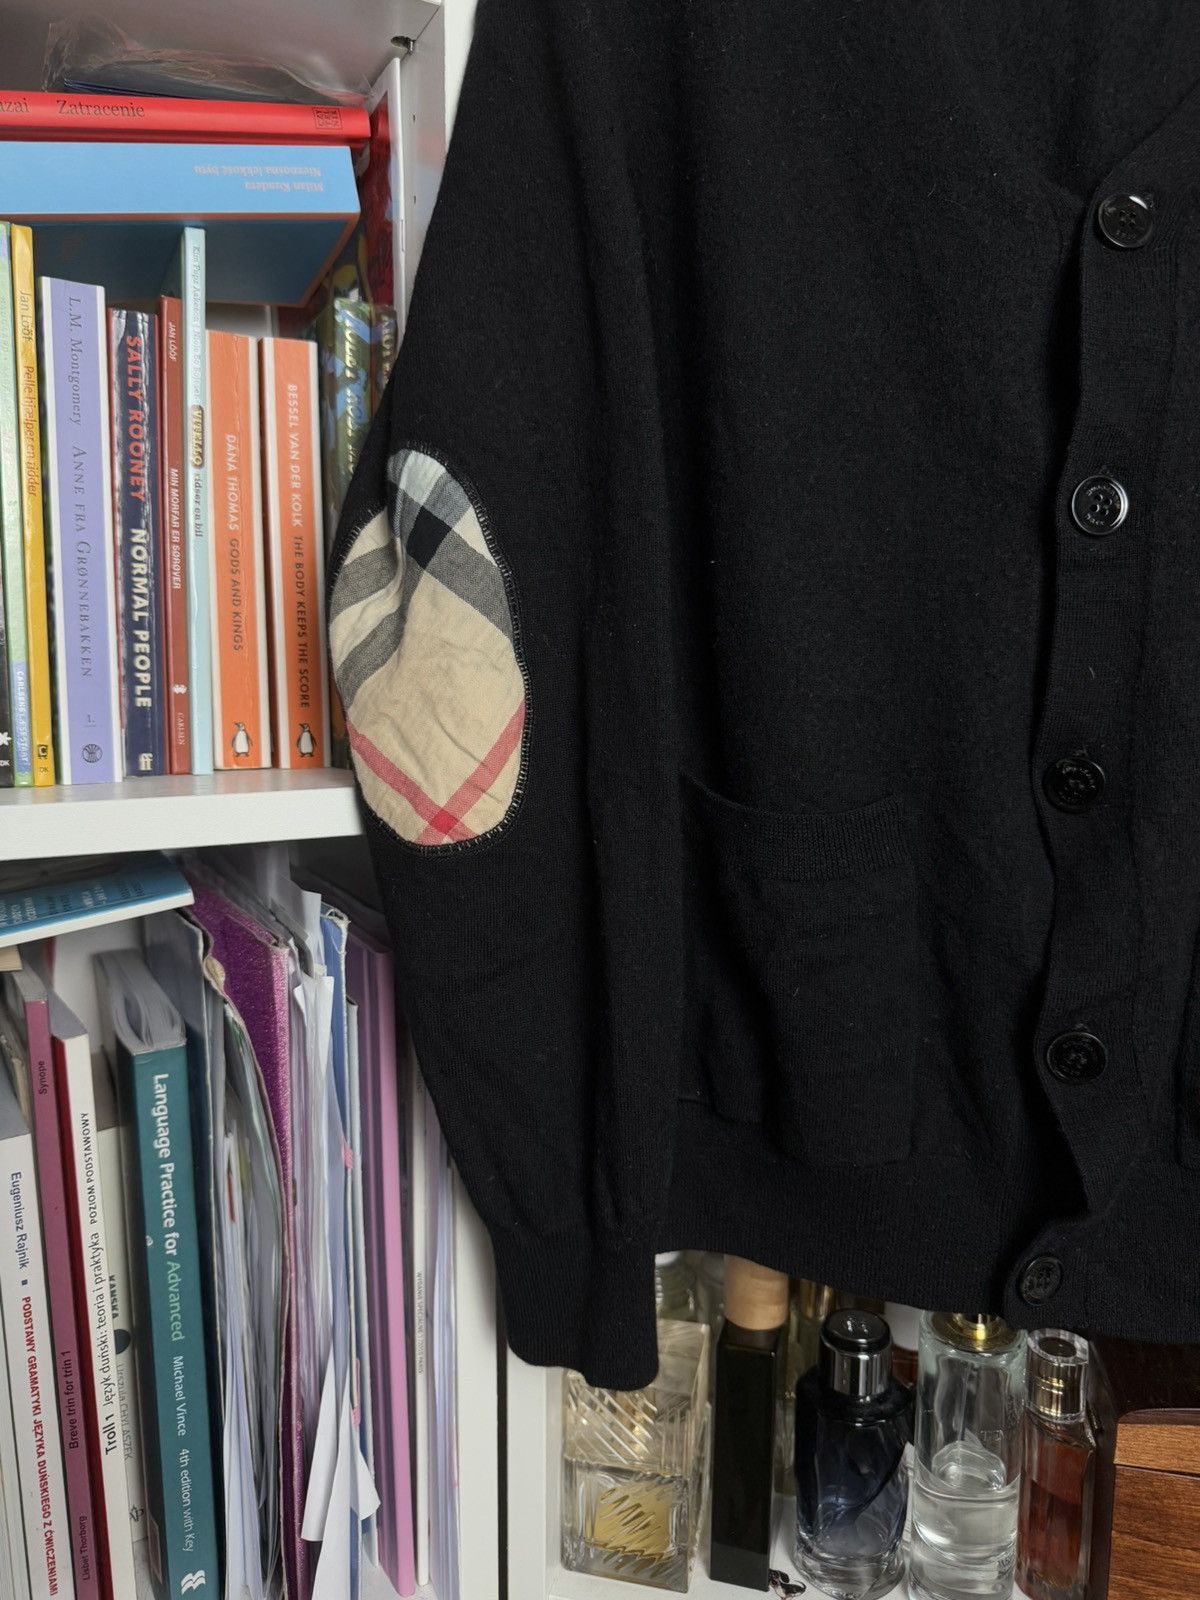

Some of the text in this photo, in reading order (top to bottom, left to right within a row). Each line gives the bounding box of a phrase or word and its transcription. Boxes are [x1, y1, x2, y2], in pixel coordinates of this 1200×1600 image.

[56, 99, 146, 117] Zatracenie
[19, 291, 31, 312] Jan
[169, 322, 177, 338] JAN
[24, 365, 36, 392] Pelle
[22, 395, 38, 442] hjælper
[26, 444, 36, 460] en
[68, 296, 92, 677] L.M. Montgomery ANNE FRA GRØNNEBAKKEN
[170, 468, 179, 486] MIN
[126, 335, 152, 708] SALLY ROONEY NORMAL PEOPLE
[171, 488, 180, 528] MORFAR
[172, 530, 180, 543] ER
[225, 434, 244, 652] DANA THOMAS GODS AND KINGS
[287, 384, 311, 709] BESSEL VAN DER KOLK THE BODY KEEPS THE SCORE
[38, 1060, 48, 1096] Synope
[80, 1112, 95, 1184] PODSTAWOWY
[87, 1184, 98, 1225] POZIOM
[88, 1232, 106, 1285] praktyka
[96, 1294, 108, 1329] teoria
[152, 1073, 195, 1553] Language Practice for Advanced Michael Vince 4th edition with Key
[63, 1358, 73, 1375] trin
[97, 1331, 112, 1375] duński:
[10, 1171, 59, 1596] Eugeniusz Rajnik PODSTAWY GRAMATYKI JĘZYKA DUŃSKIEGO Z ĆWICZENIAMI
[65, 1376, 75, 1392] for
[66, 1393, 77, 1416] trin
[68, 1418, 79, 1449] Breve
[102, 1422, 118, 1456] Troll
[79, 1515, 88, 1555] Thorborg
